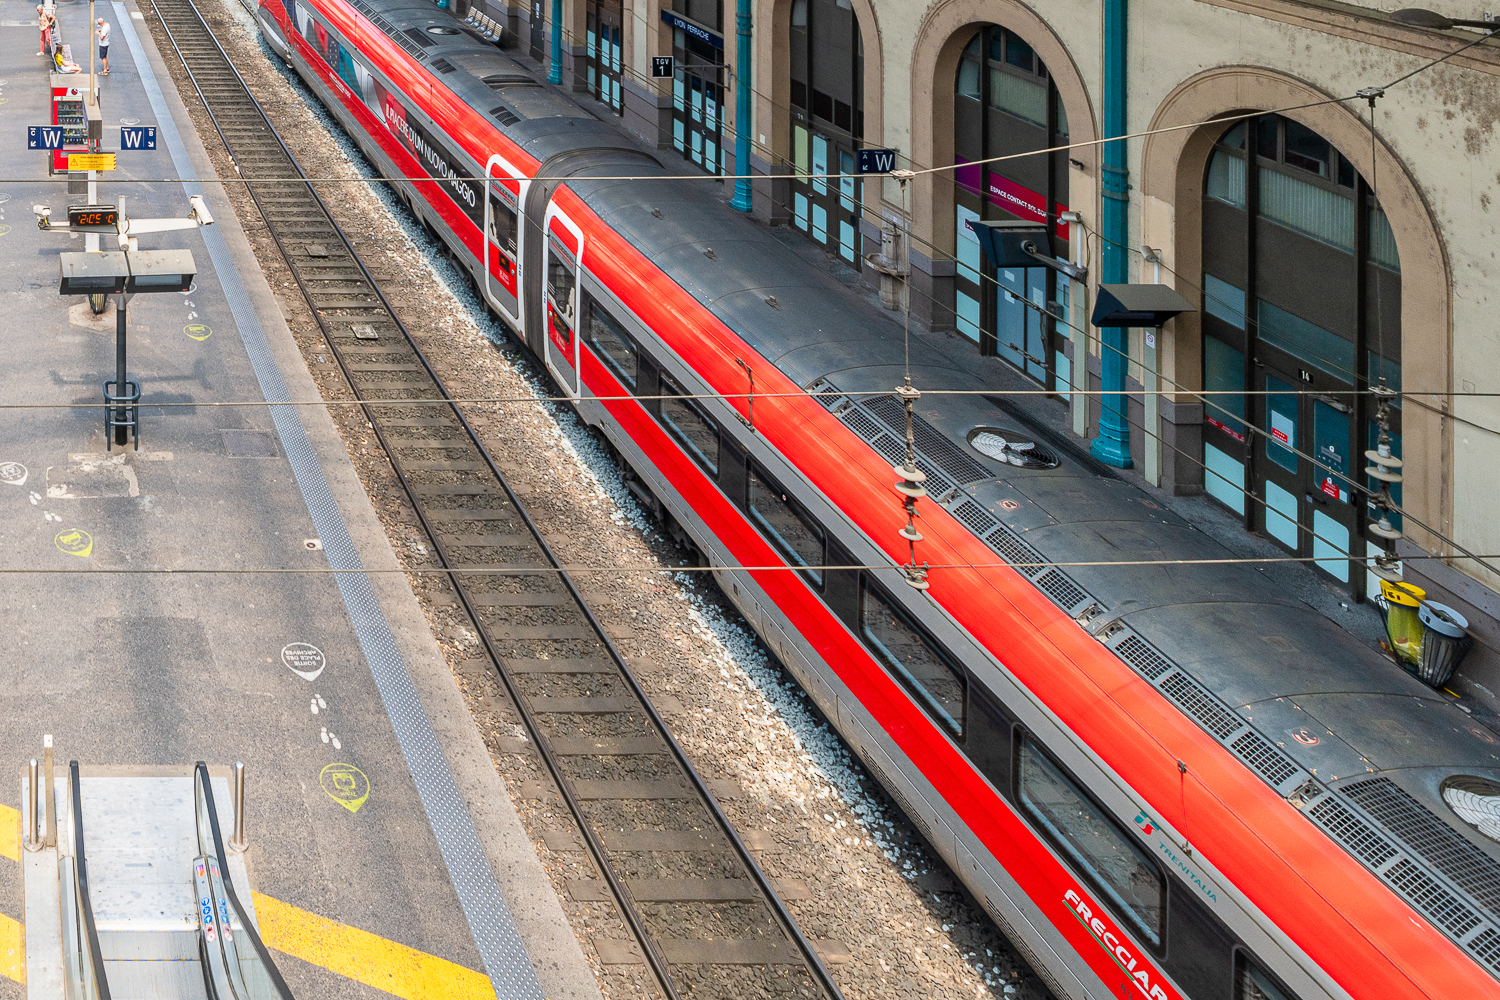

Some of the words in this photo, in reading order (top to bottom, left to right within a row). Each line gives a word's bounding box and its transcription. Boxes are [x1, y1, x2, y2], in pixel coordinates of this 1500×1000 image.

[674, 18, 686, 29] LYON
[687, 24, 709, 41] PERRACHE
[659, 66, 664, 76] 1
[43, 130, 61, 148] W
[124, 131, 142, 148] W
[390, 108, 409, 138] PIACERE
[424, 146, 447, 177] NUOVO
[448, 169, 475, 207] VIAGGIO
[875, 154, 892, 171] W
[990, 185, 1007, 199] ESPACE
[1007, 193, 1027, 208] CONTACT
[1301, 371, 1310, 381] 14
[1159, 842, 1217, 903] TRENITALIA
[1064, 889, 1168, 1000] FRECCIAR
